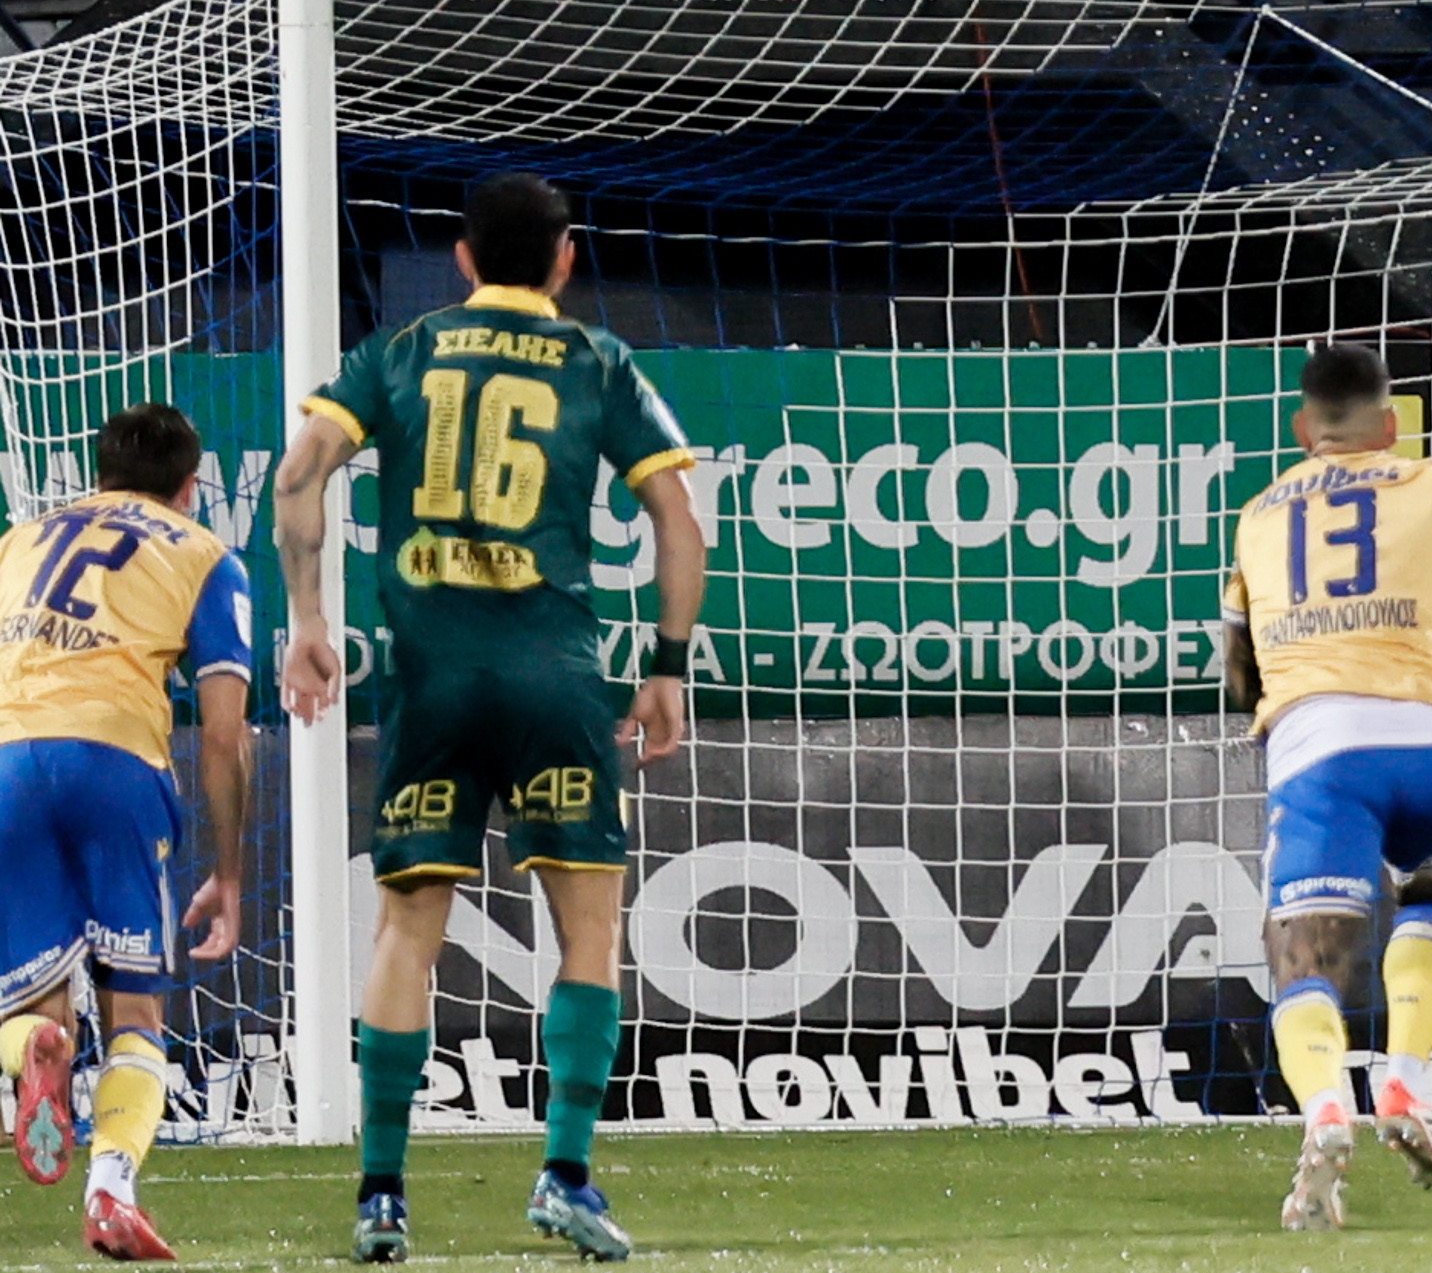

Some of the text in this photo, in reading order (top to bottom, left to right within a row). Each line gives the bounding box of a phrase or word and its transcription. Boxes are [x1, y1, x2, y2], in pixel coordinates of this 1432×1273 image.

[413, 368, 560, 529] 16
[1287, 487, 1377, 606] 13
[655, 1026, 1199, 1120] novibet
